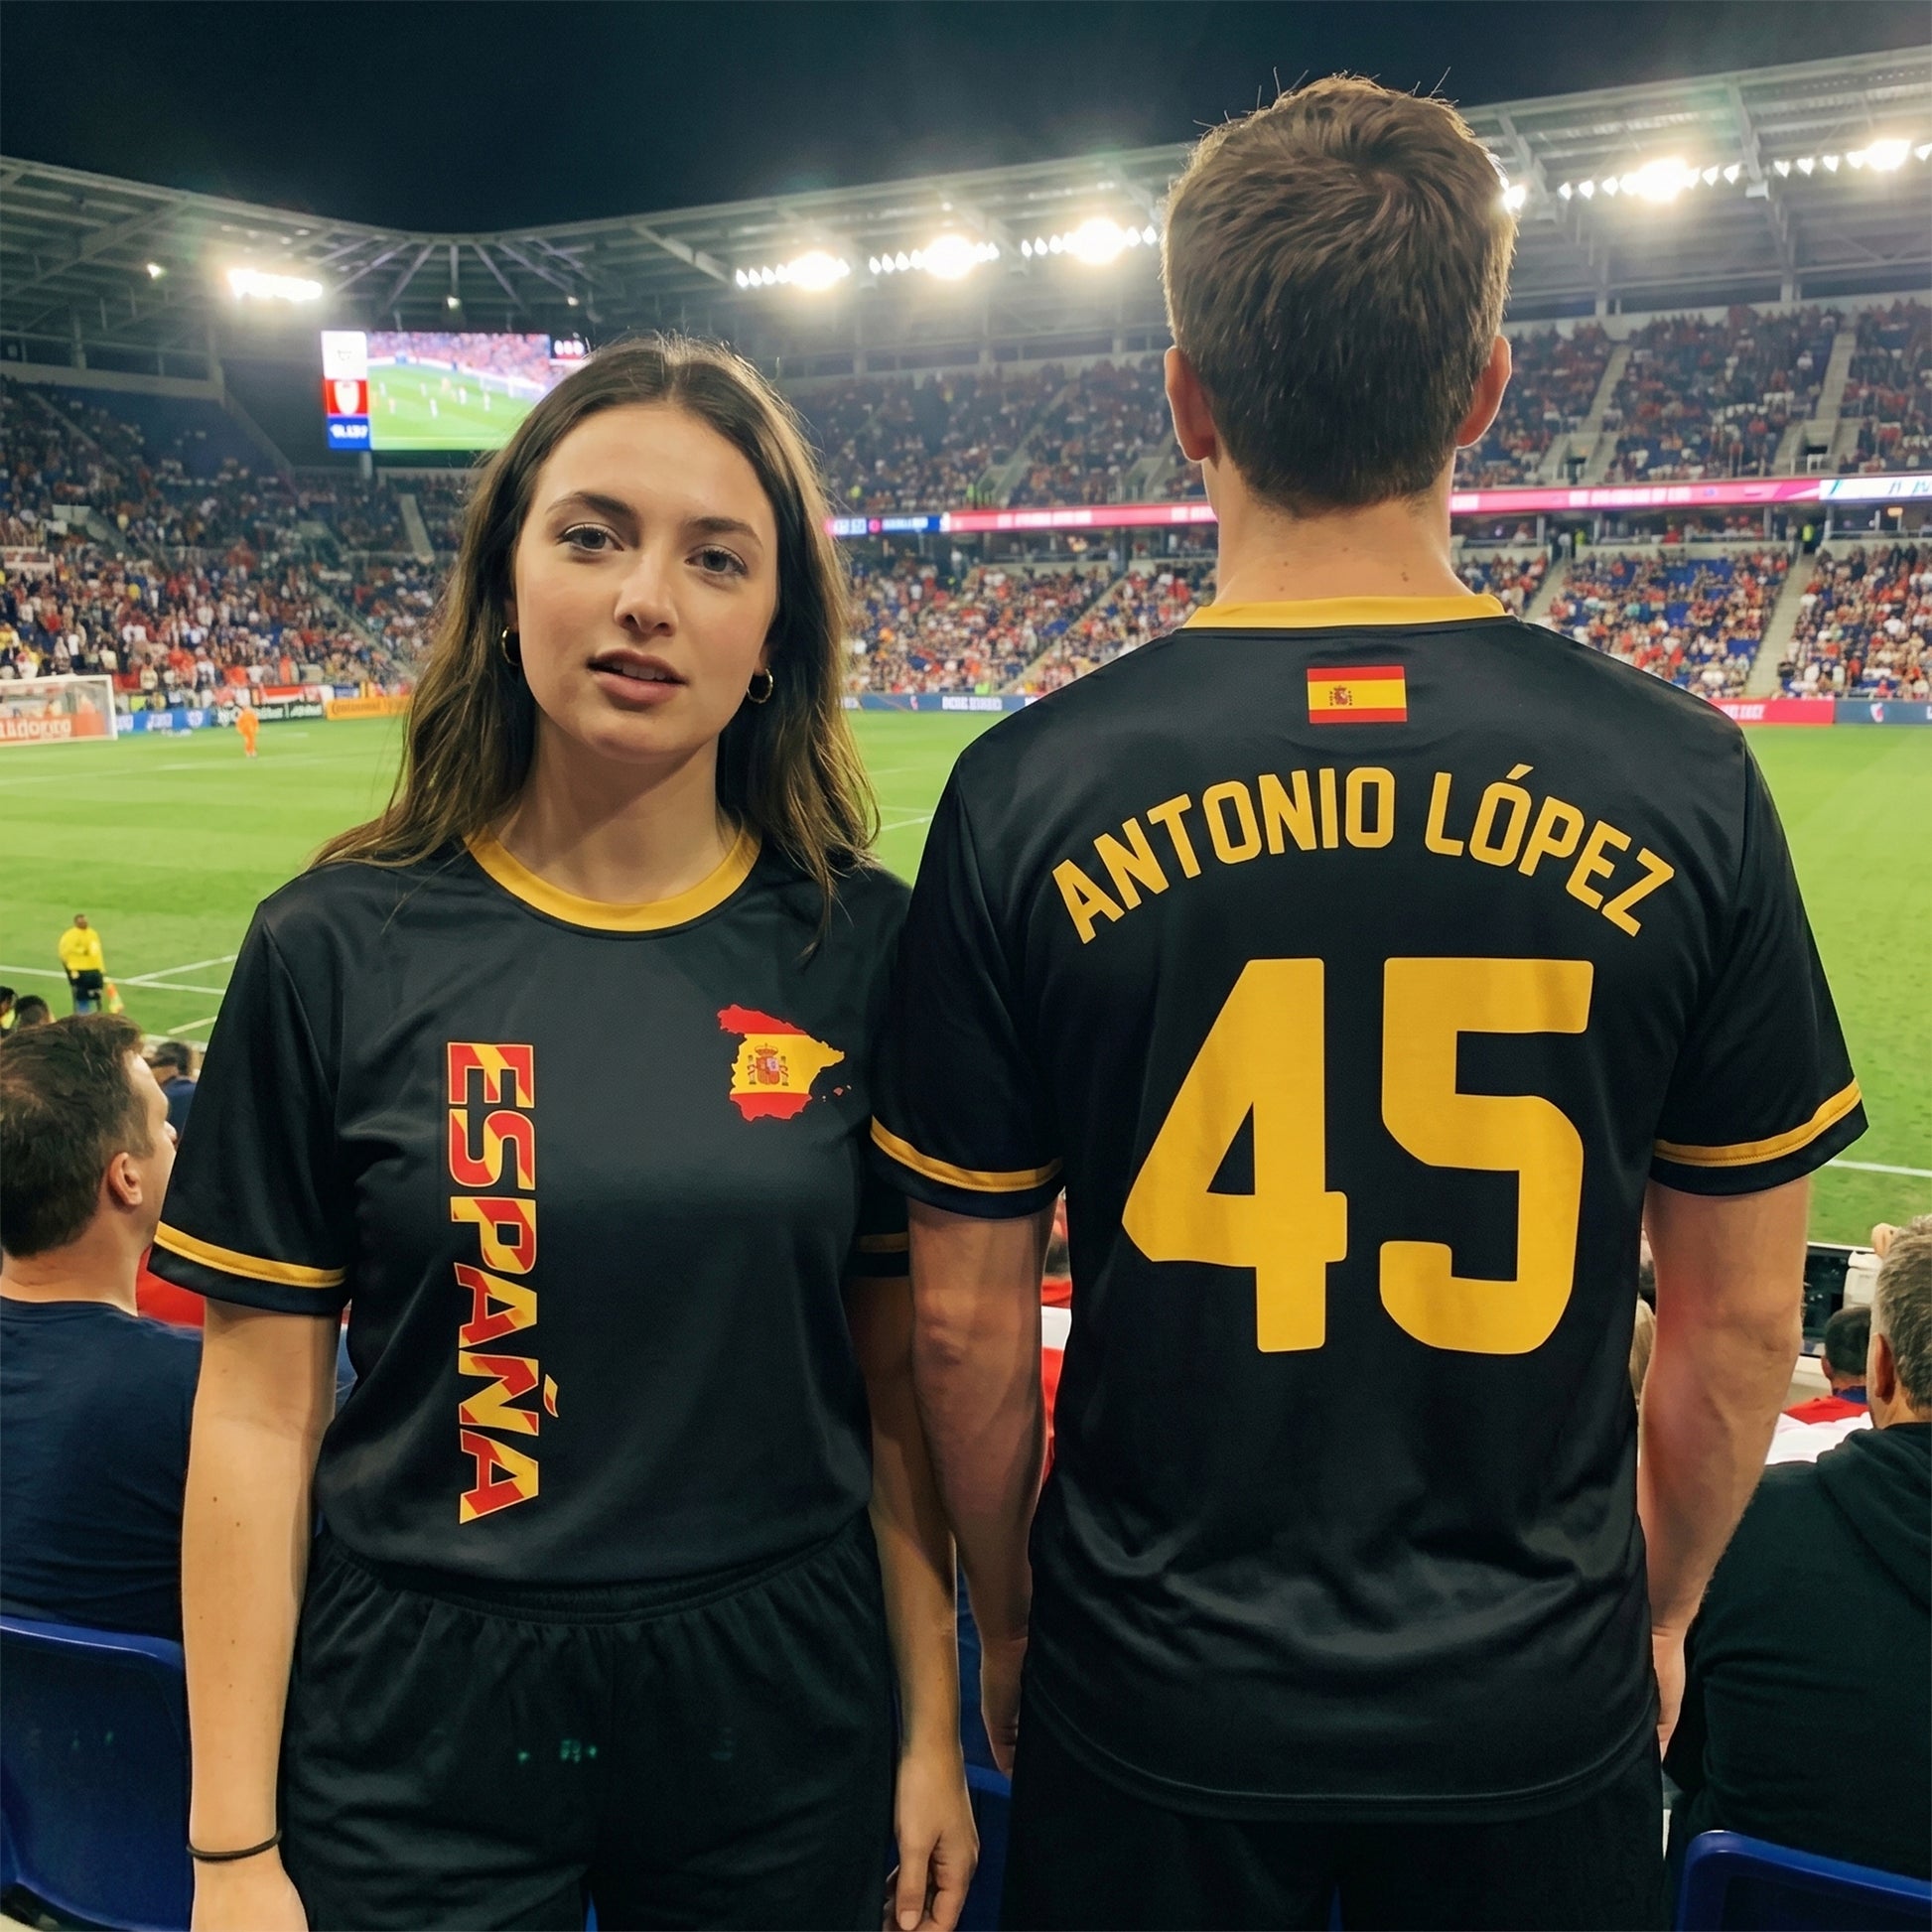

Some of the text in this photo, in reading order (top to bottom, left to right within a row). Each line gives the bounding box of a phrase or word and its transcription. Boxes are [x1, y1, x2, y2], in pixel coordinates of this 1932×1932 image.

[1052, 763, 1675, 944] ANTONIO LÓPEZ
[447, 1041, 559, 1525] ESPAÑA
[1121, 957, 1594, 1354] 45
